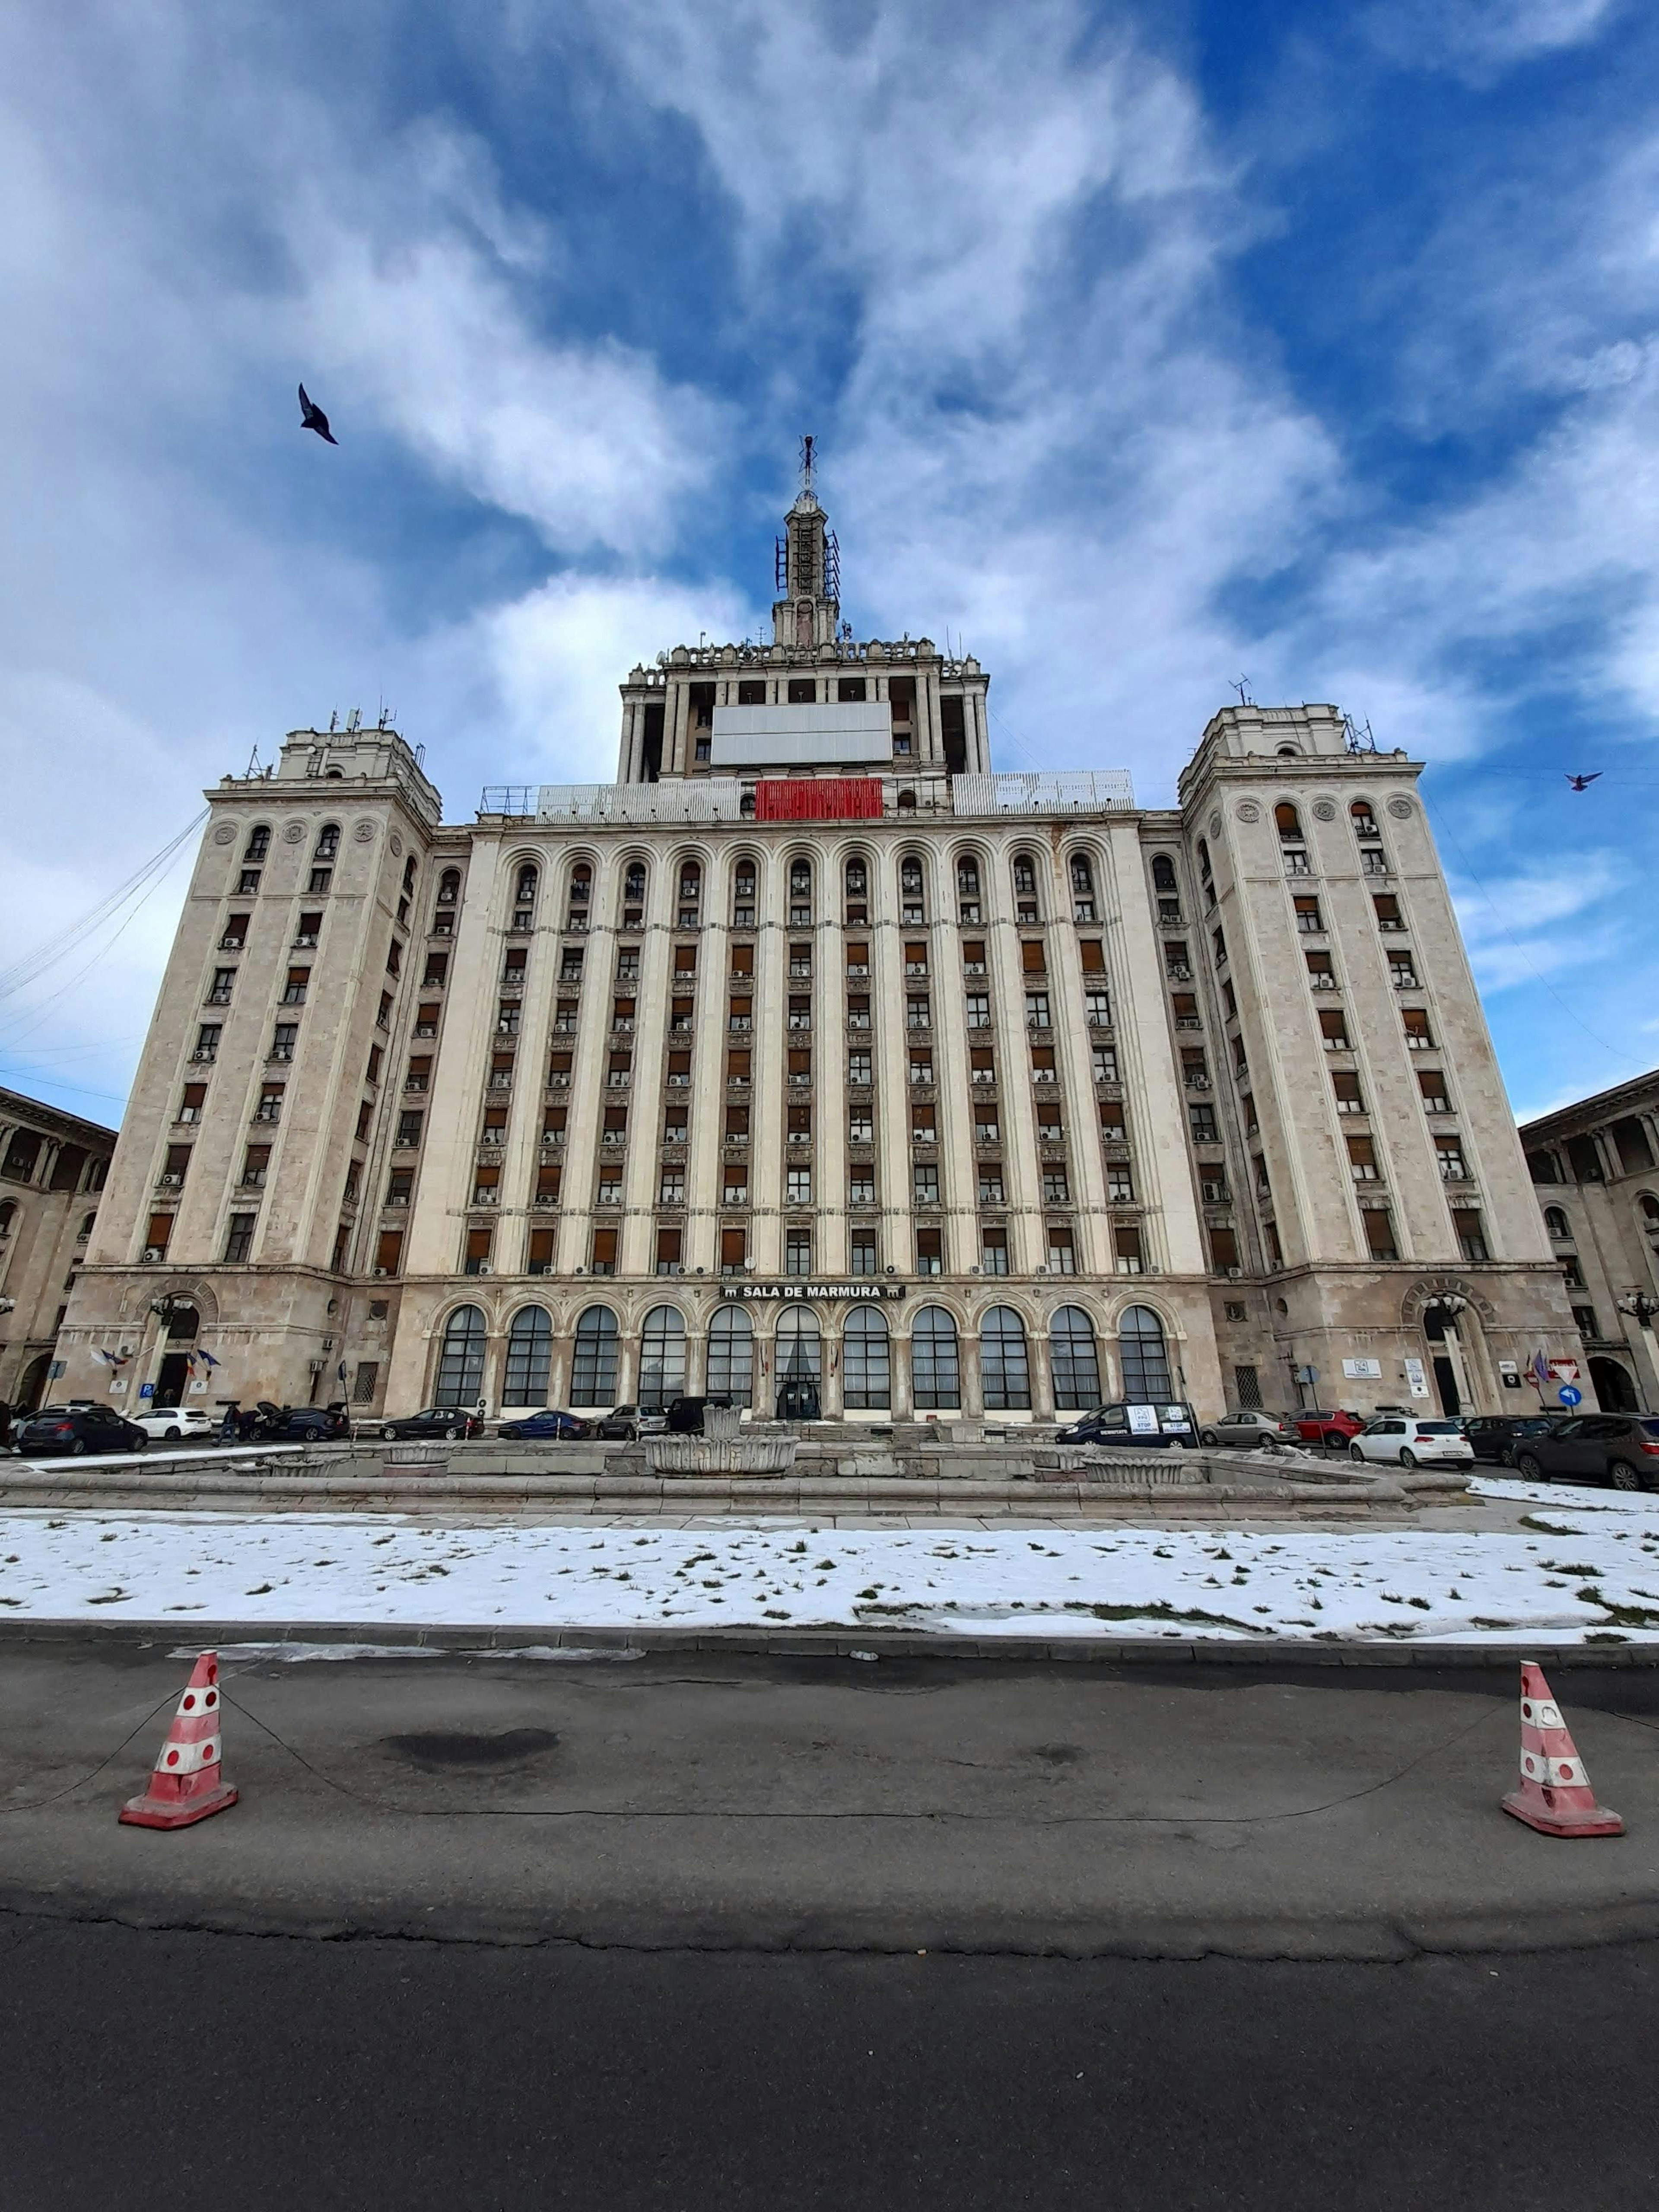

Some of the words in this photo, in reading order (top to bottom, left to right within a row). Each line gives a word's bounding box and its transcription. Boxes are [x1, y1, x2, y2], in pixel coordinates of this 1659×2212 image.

[744, 1287, 779, 1297] SALA
[785, 1287, 802, 1297] DE
[807, 1287, 880, 1297] MARMURA
